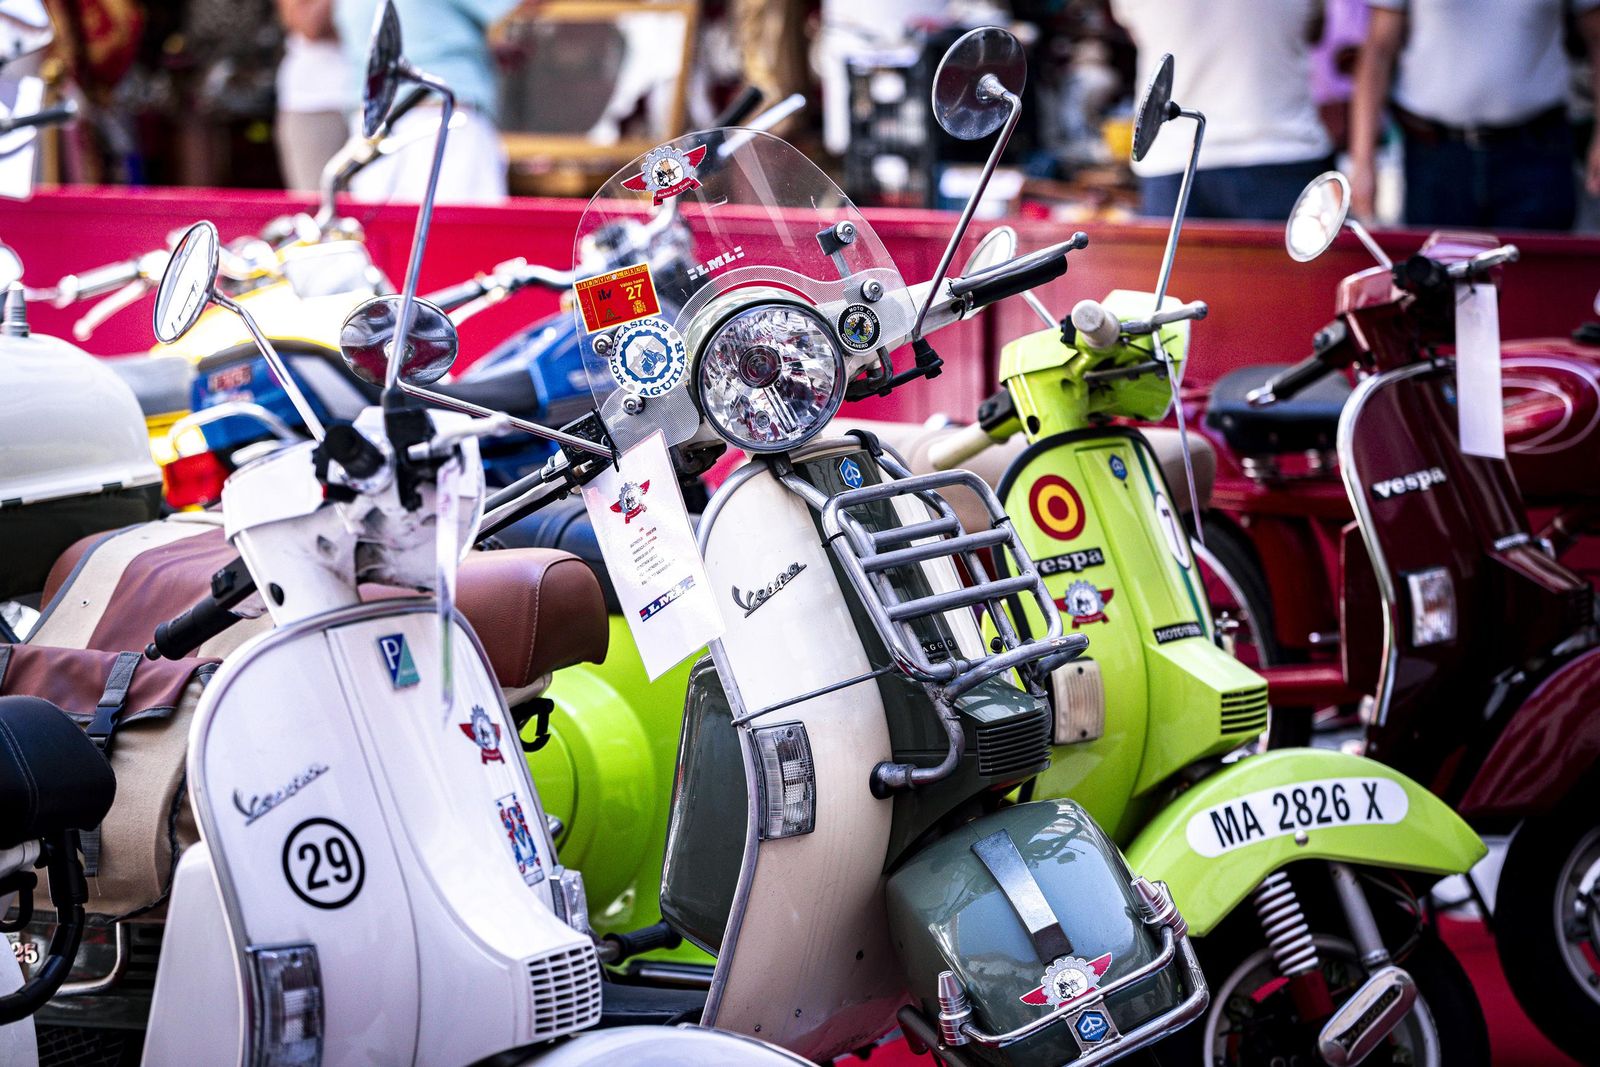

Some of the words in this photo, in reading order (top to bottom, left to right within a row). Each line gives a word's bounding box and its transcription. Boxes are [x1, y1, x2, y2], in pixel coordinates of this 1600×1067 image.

[692, 249, 740, 278] LML
[626, 284, 642, 300] 27
[866, 310, 877, 323] CLUB
[639, 341, 685, 396] AGUILAR
[1373, 467, 1446, 498] vespa
[732, 562, 807, 618] Vespa
[1210, 801, 1265, 848] MA
[1273, 784, 1350, 831] 2826
[1362, 782, 1384, 821] X
[298, 837, 352, 890] 29
